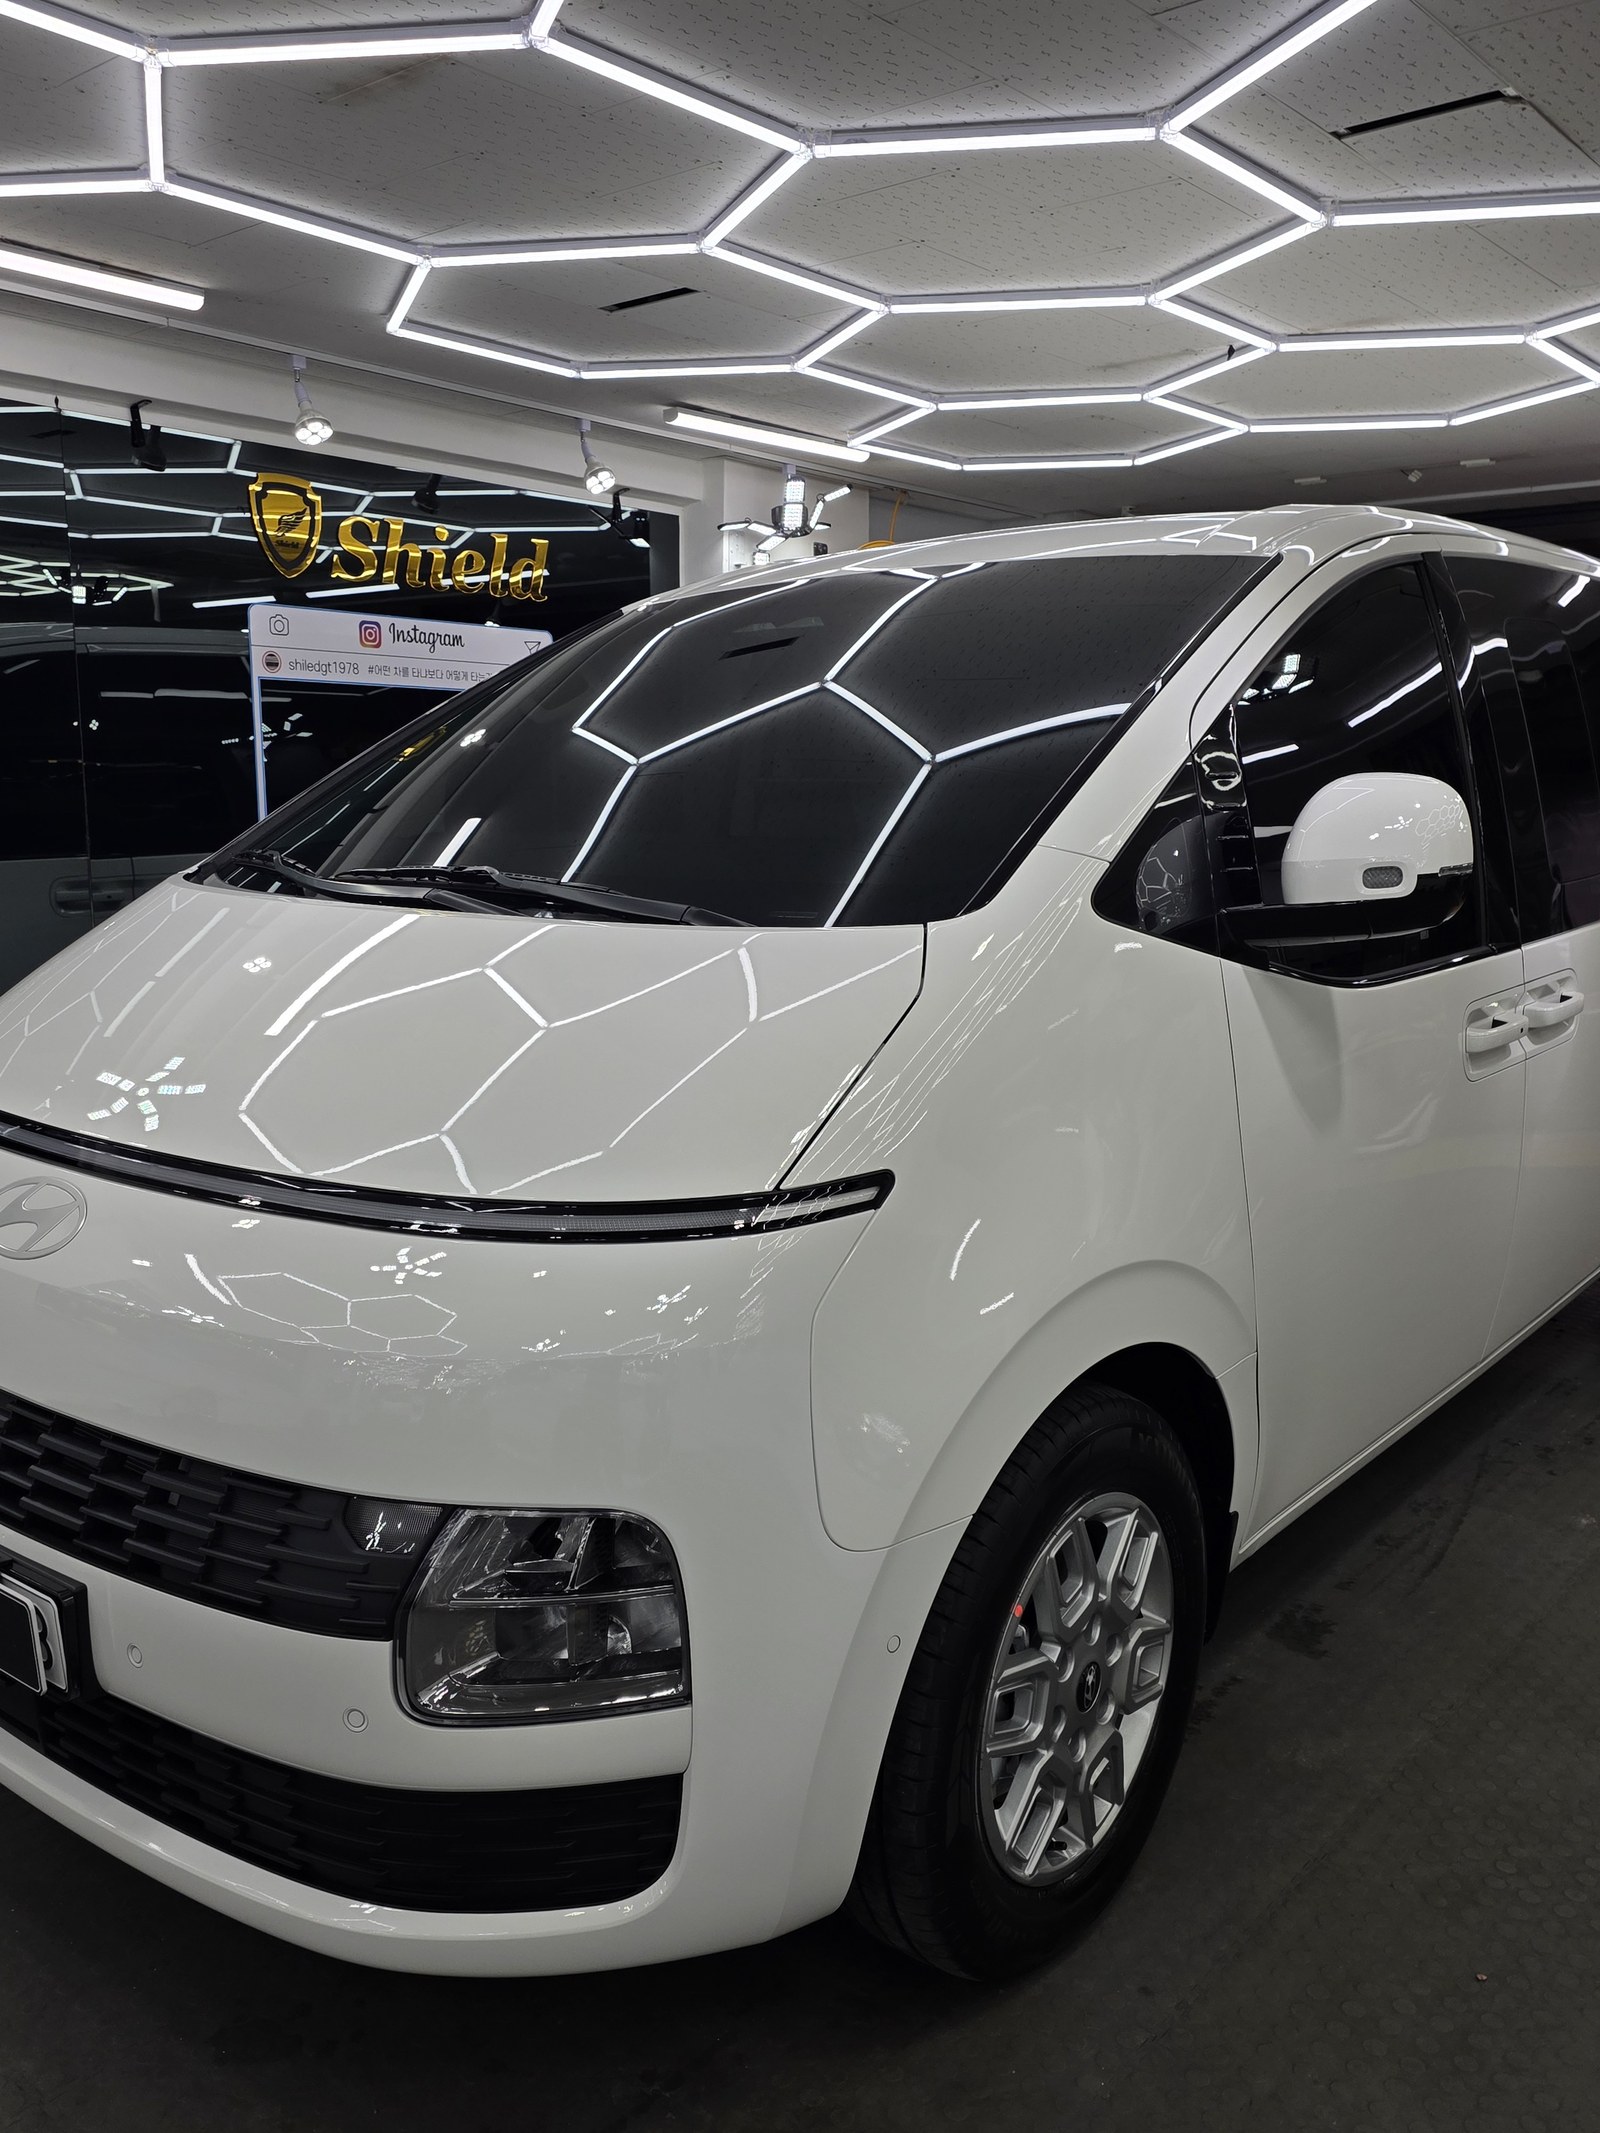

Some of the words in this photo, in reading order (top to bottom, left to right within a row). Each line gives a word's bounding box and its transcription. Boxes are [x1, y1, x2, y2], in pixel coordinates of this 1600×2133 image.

[331, 516, 549, 602] Shield
[388, 623, 465, 653] Instagram
[288, 659, 360, 676] shiledgt1978
[368, 664, 391, 677] #어떤
[393, 666, 409, 678] 차를
[445, 670, 469, 681] 어떻게
